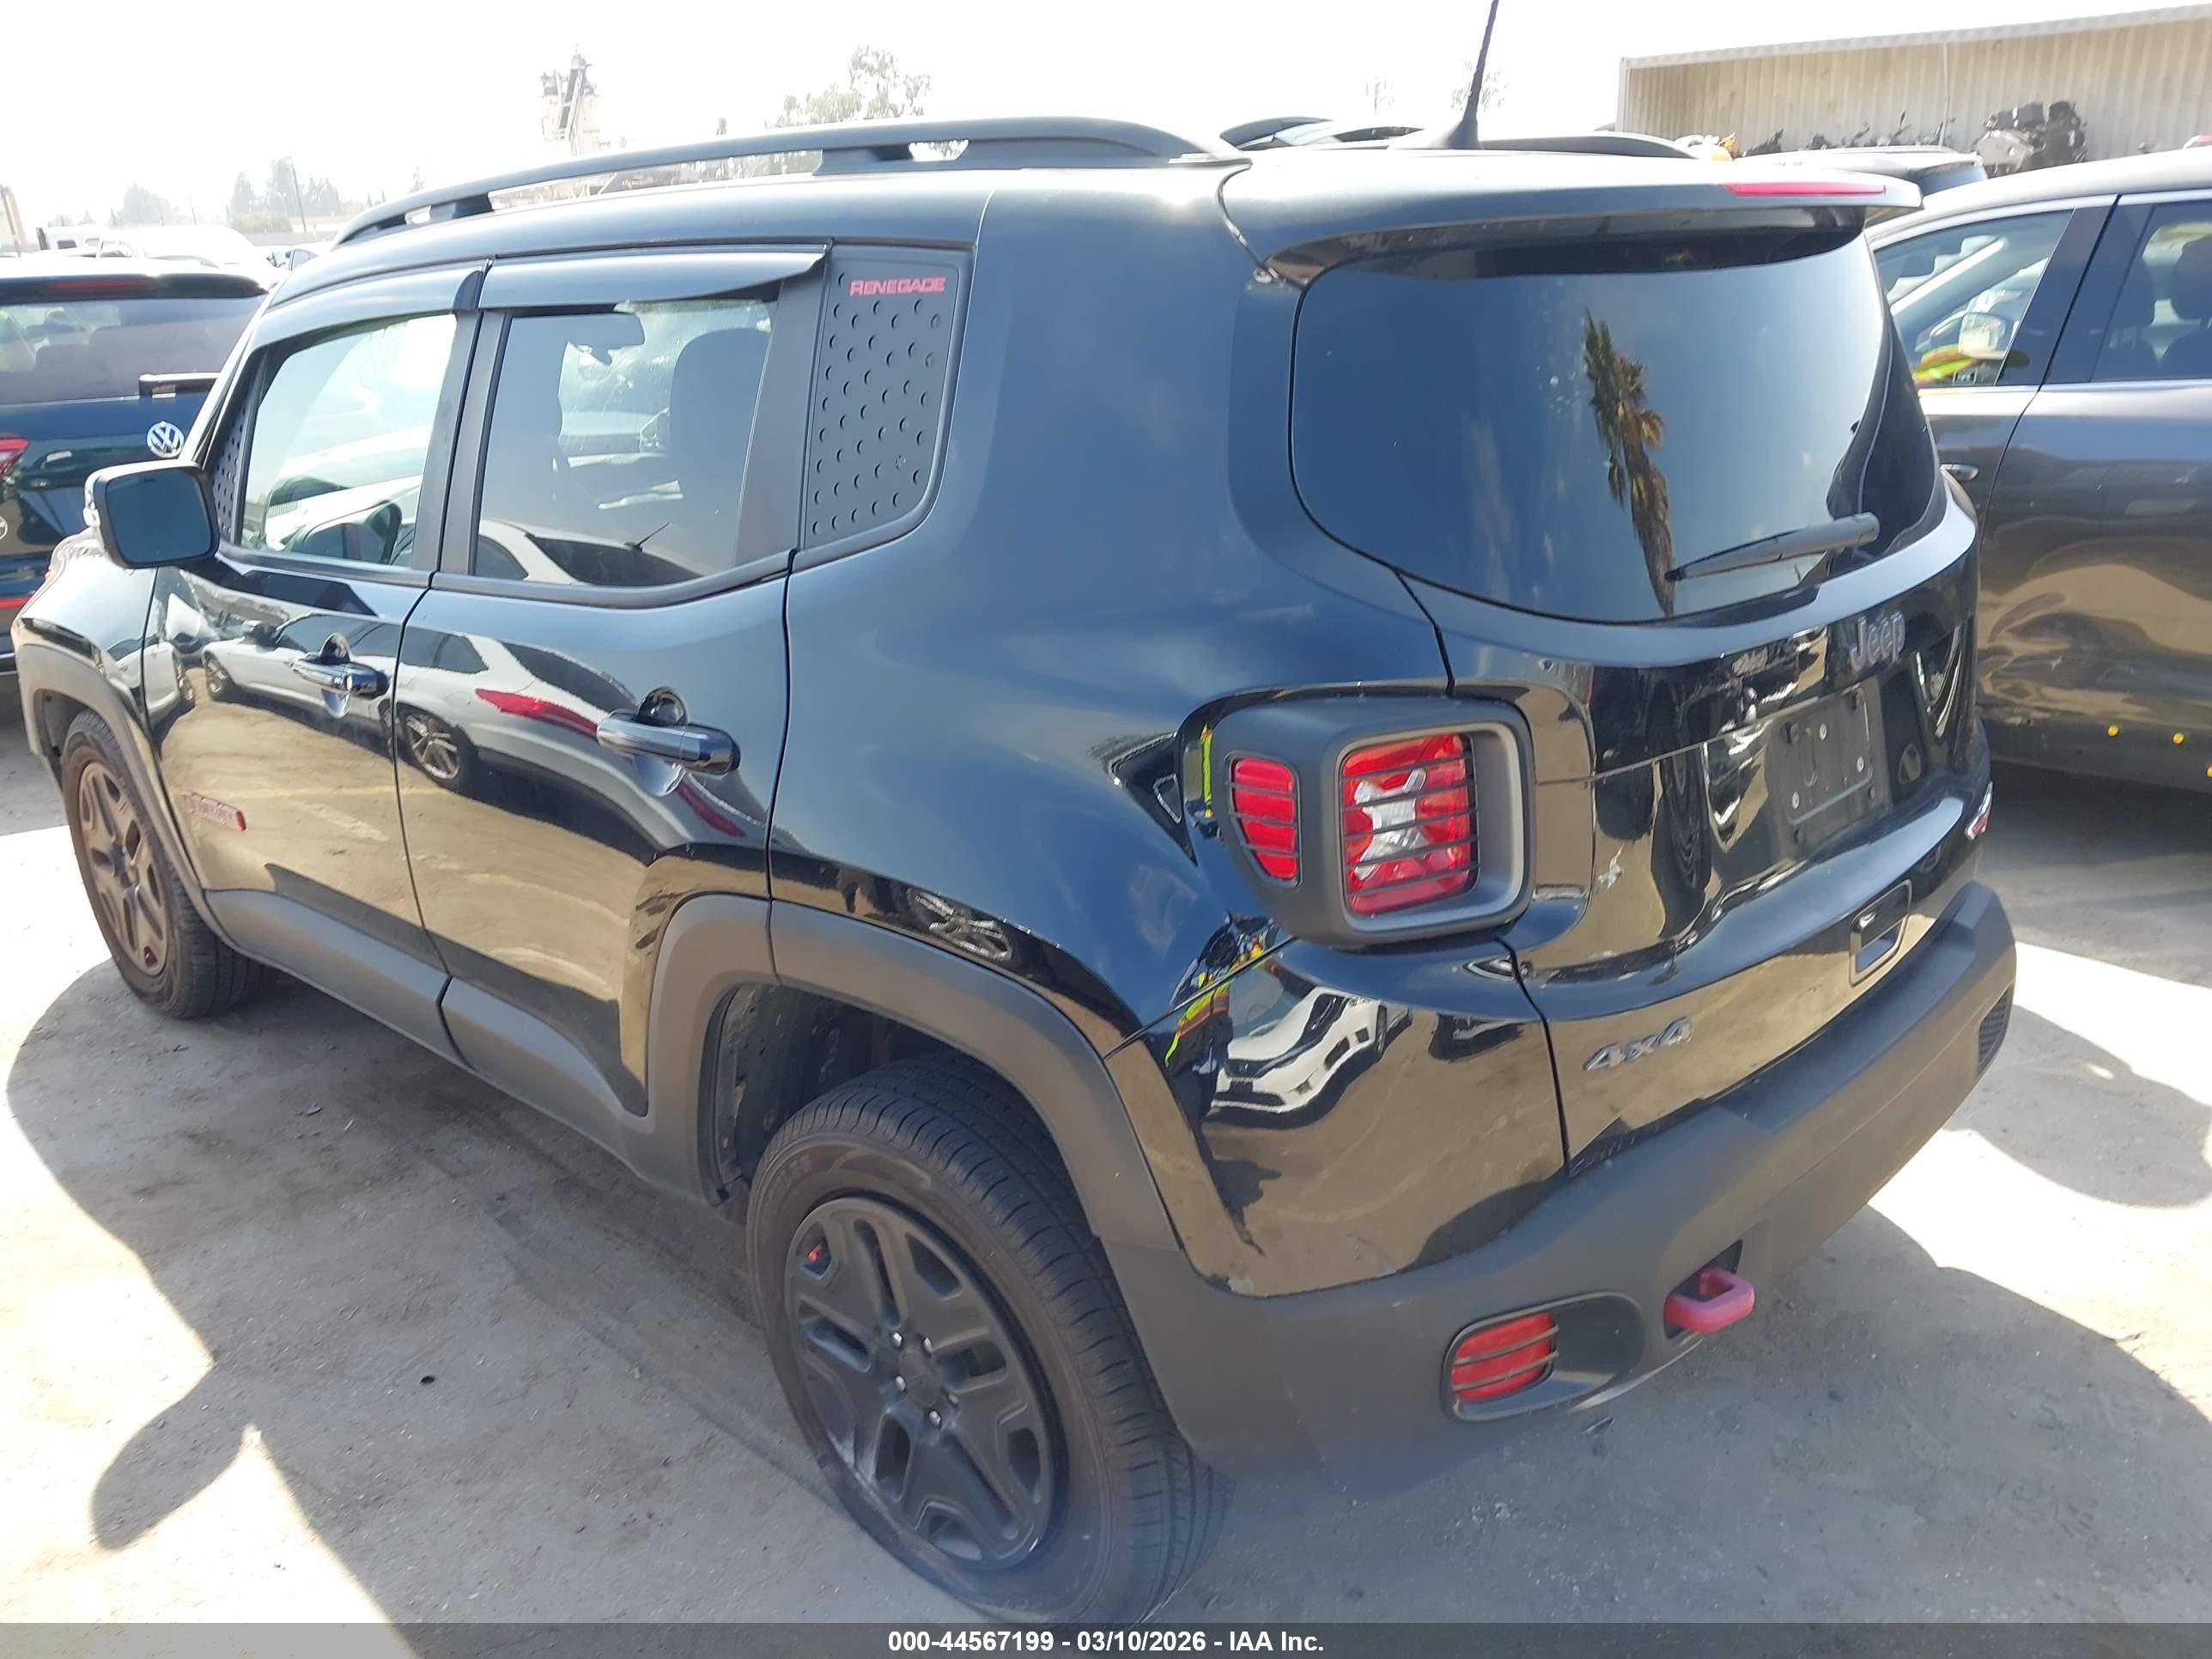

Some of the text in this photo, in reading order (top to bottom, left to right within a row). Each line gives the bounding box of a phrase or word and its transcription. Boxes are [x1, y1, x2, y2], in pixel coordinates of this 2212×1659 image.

[850, 276, 945, 295] RENEGADE
[1850, 611, 1905, 672] Jeep
[1583, 1016, 1692, 1071] 4x4
